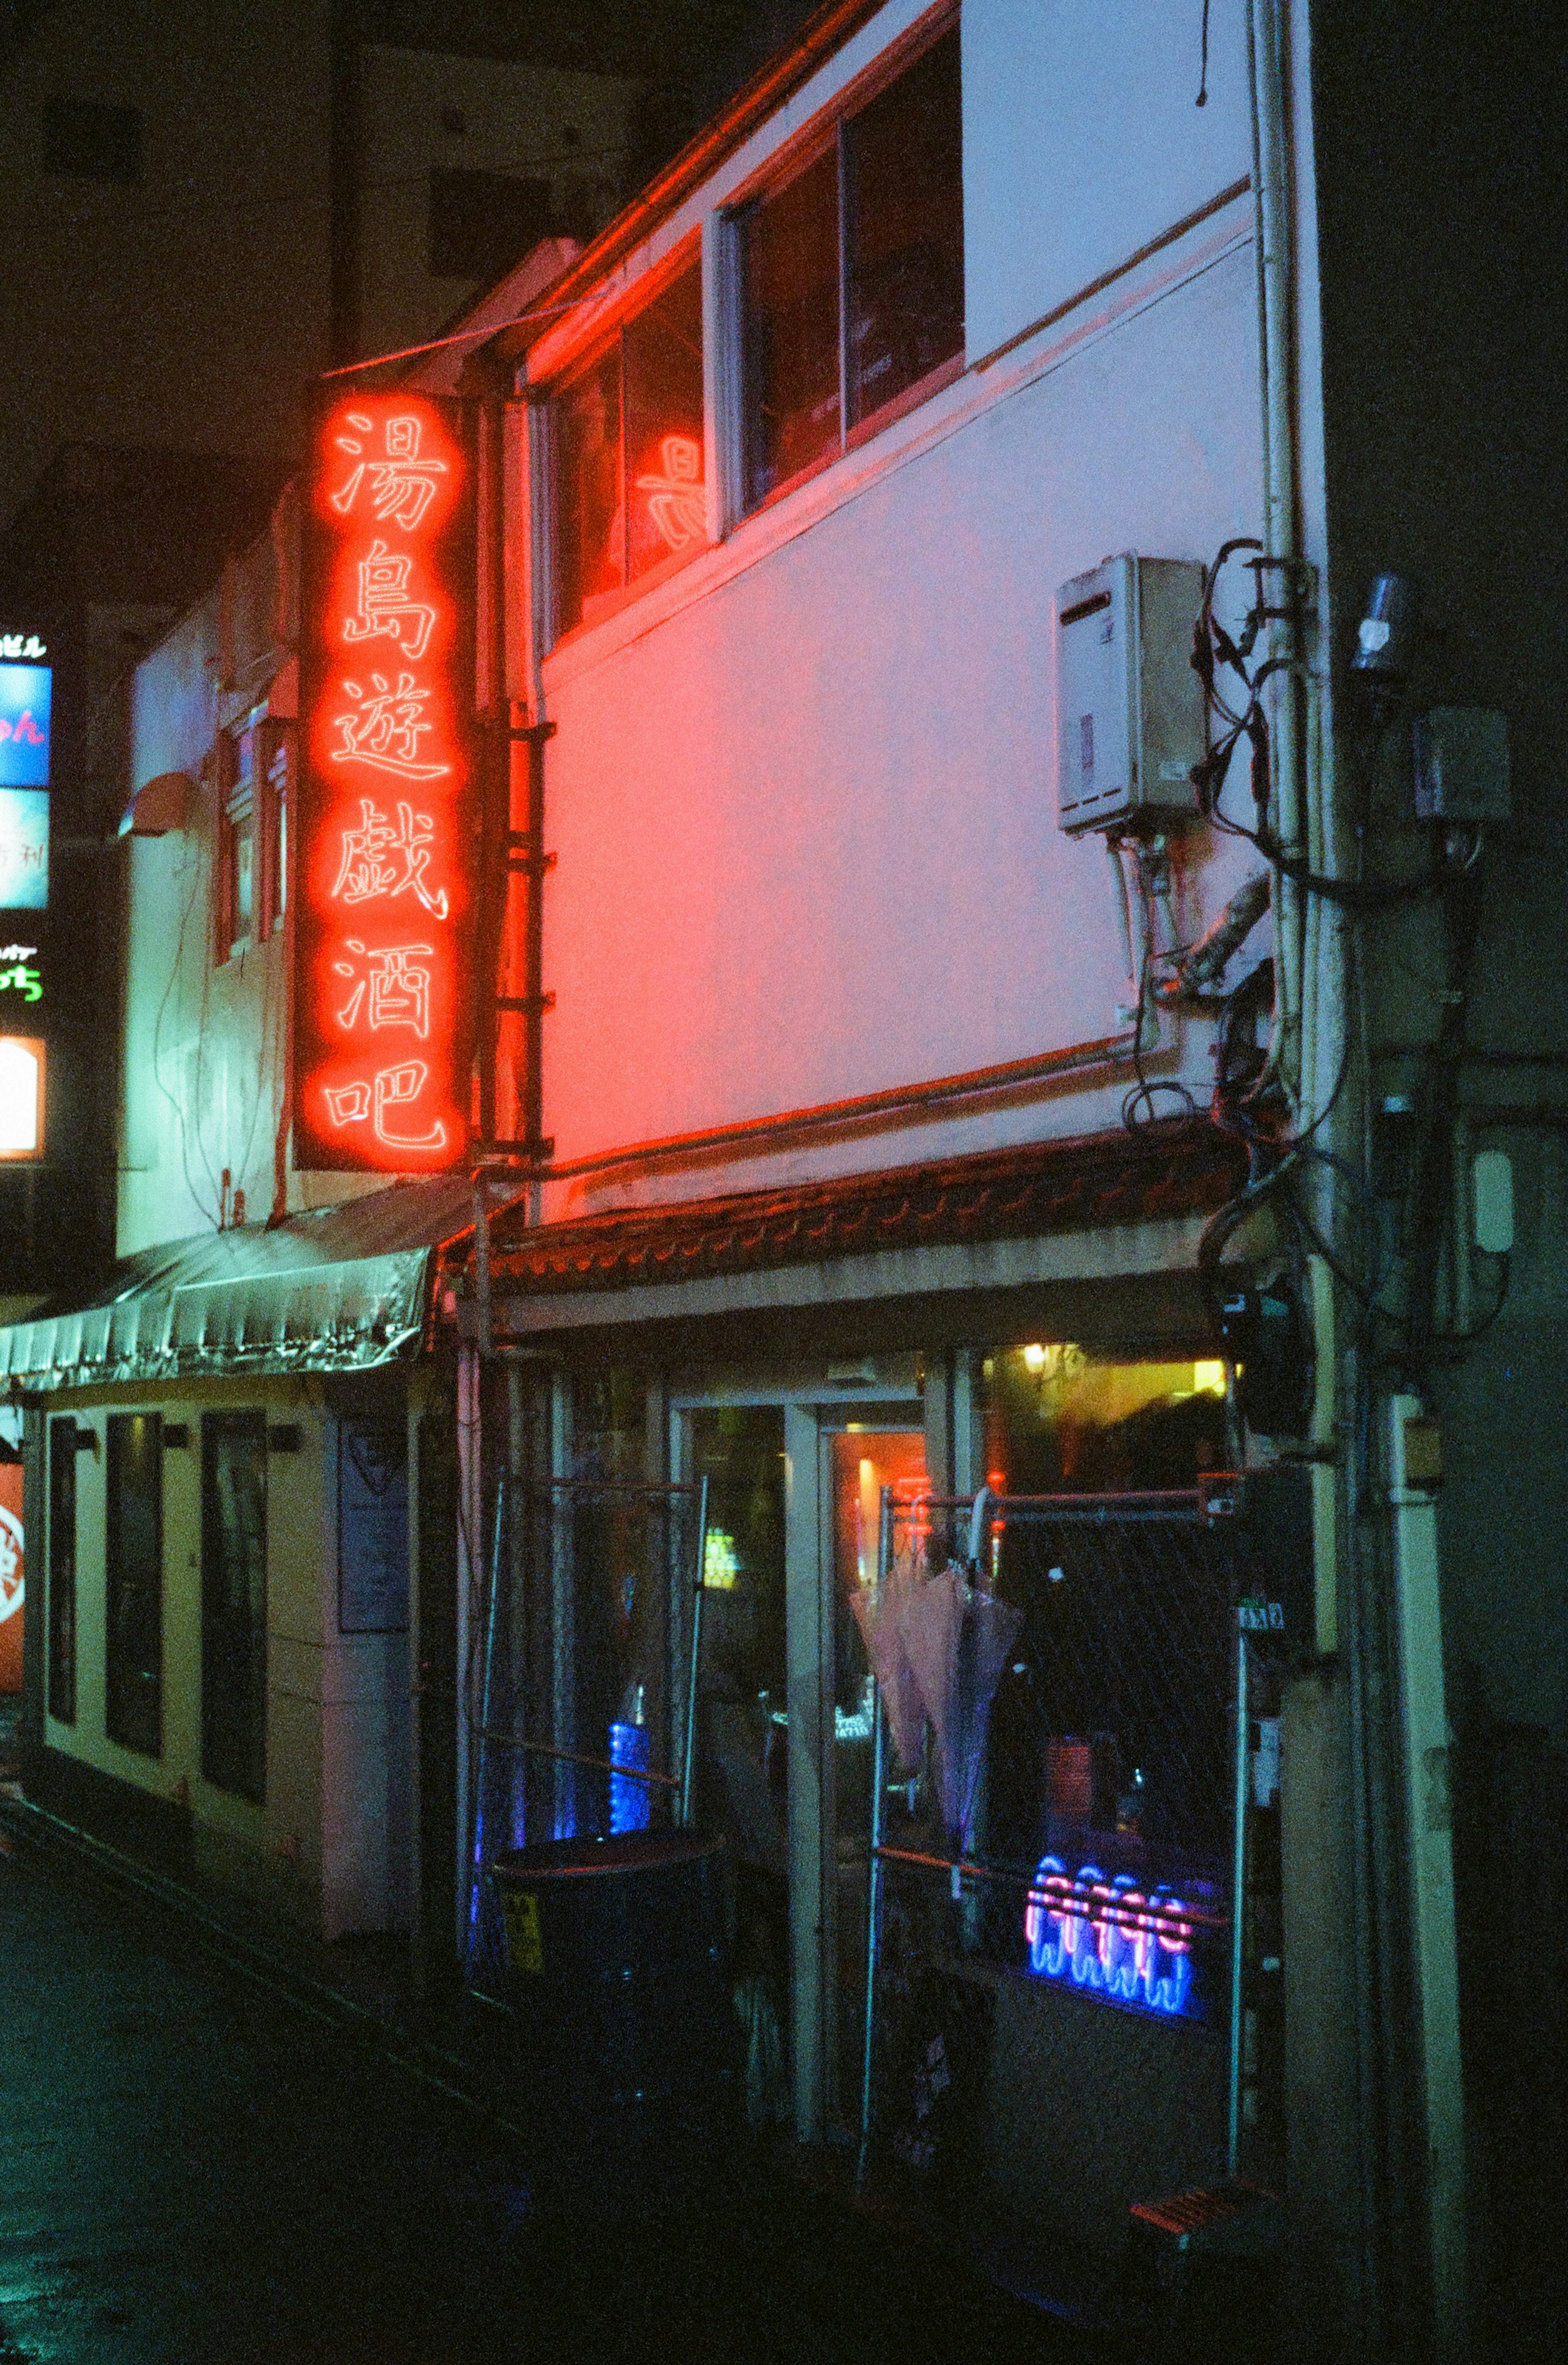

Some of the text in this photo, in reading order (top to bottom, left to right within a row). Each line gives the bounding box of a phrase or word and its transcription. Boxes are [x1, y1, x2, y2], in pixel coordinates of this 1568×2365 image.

[0, 633, 47, 659] ビル
[325, 415, 450, 1148] 湯島遊戯酒吧
